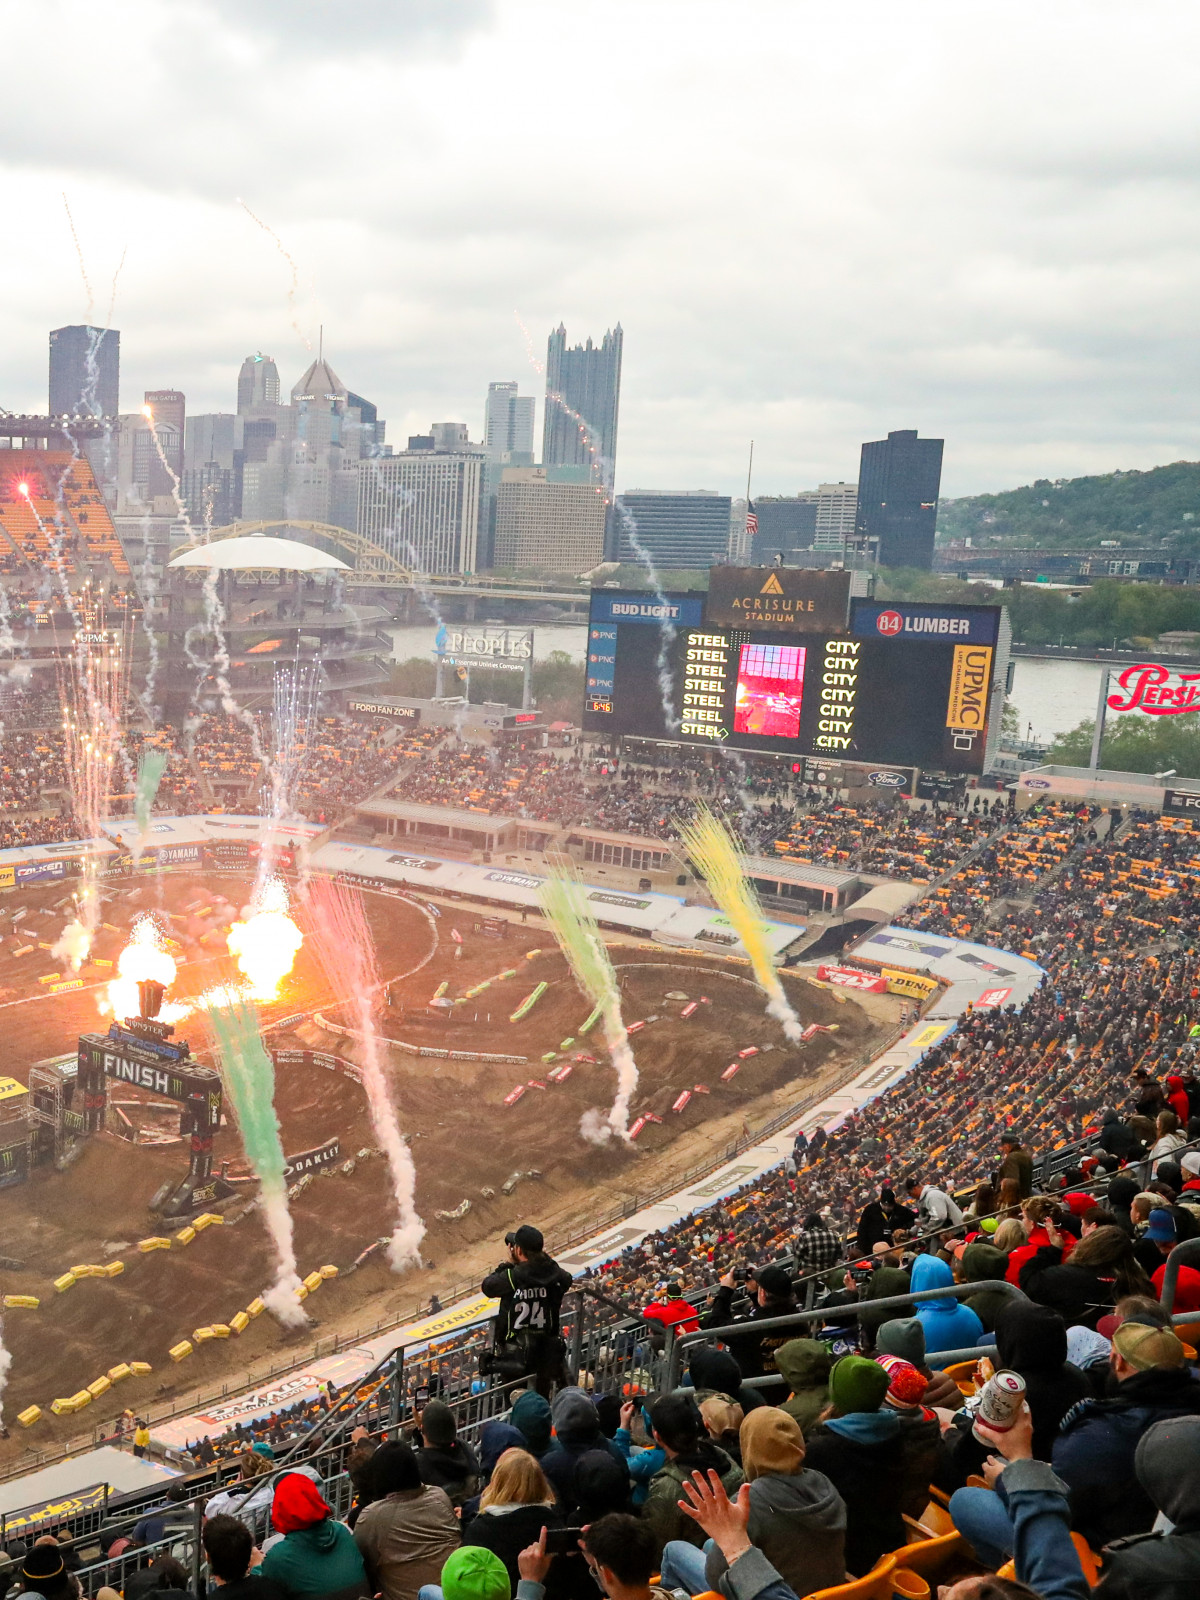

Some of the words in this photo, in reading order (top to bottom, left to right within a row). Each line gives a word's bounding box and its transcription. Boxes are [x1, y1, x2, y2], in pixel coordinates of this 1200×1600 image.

[612, 603, 639, 615] BUD
[641, 604, 680, 618] LIGHT
[732, 597, 815, 612] ACRISURE
[745, 612, 794, 622] STADIUM
[879, 615, 899, 631] 84
[905, 616, 969, 635] LUMBER
[80, 634, 108, 642] UPMC
[600, 632, 616, 640] PNC
[688, 634, 729, 648] STEEL
[825, 641, 860, 654] CITY
[598, 656, 615, 664] PNC
[687, 649, 728, 663] STEEL
[455, 659, 478, 667] Essential
[478, 660, 498, 669] Utilities
[499, 663, 524, 671] Company
[685, 664, 726, 677] STEEL
[824, 657, 859, 670] CITY
[596, 680, 613, 688] PNC
[685, 678, 725, 692] STEEL
[822, 672, 857, 686] CITY
[954, 665, 962, 695] CHANGING
[959, 650, 987, 725] UPMC
[683, 693, 724, 707] STEEL
[821, 688, 856, 702] CITY
[355, 703, 376, 713] FORD
[378, 706, 392, 715] FAN
[393, 708, 415, 718] ZONE
[593, 702, 611, 712] 6:46
[820, 704, 854, 718] CITY
[682, 708, 723, 722] STEEL
[681, 723, 721, 737] STEEL
[818, 720, 852, 733] CITY
[816, 735, 851, 749] CITY
[873, 772, 899, 785] Ford
[168, 847, 199, 859] YAMAHA
[17, 862, 63, 876] FALKEN
[350, 876, 384, 887] OAKLEY
[500, 874, 539, 888] YAMAHA
[125, 1018, 164, 1037] MONSTER
[103, 1053, 170, 1094] FINISH
[296, 1144, 340, 1171] OAKLEY
[513, 1287, 547, 1299] PHOTO
[514, 1301, 546, 1330] 24
